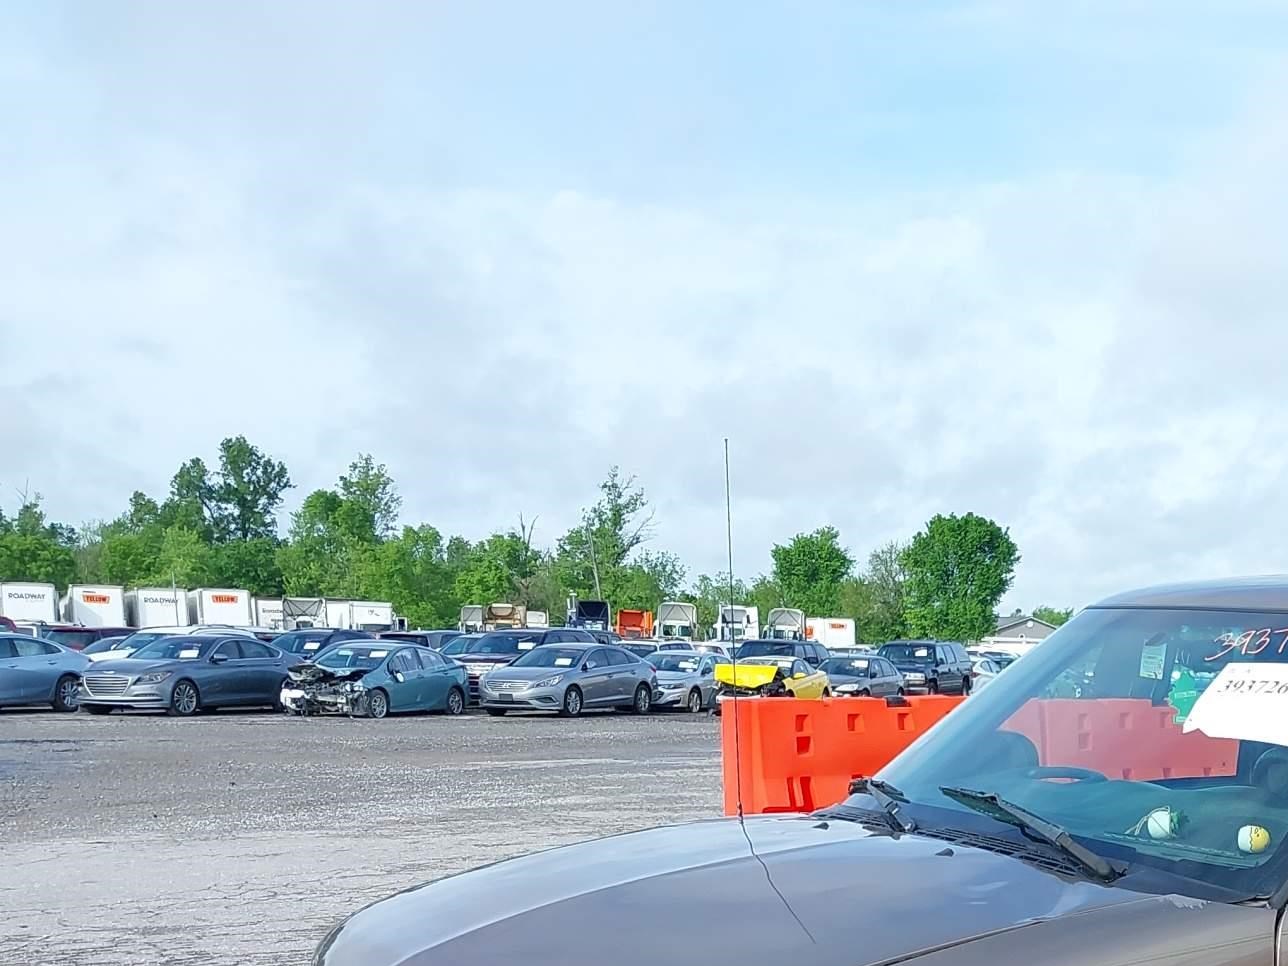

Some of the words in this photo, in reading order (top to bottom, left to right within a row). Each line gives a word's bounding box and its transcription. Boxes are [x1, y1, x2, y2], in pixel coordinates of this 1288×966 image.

[8, 592, 46, 600] ROADWAY
[85, 595, 108, 603] YELLOW
[214, 595, 236, 603] YELLOW
